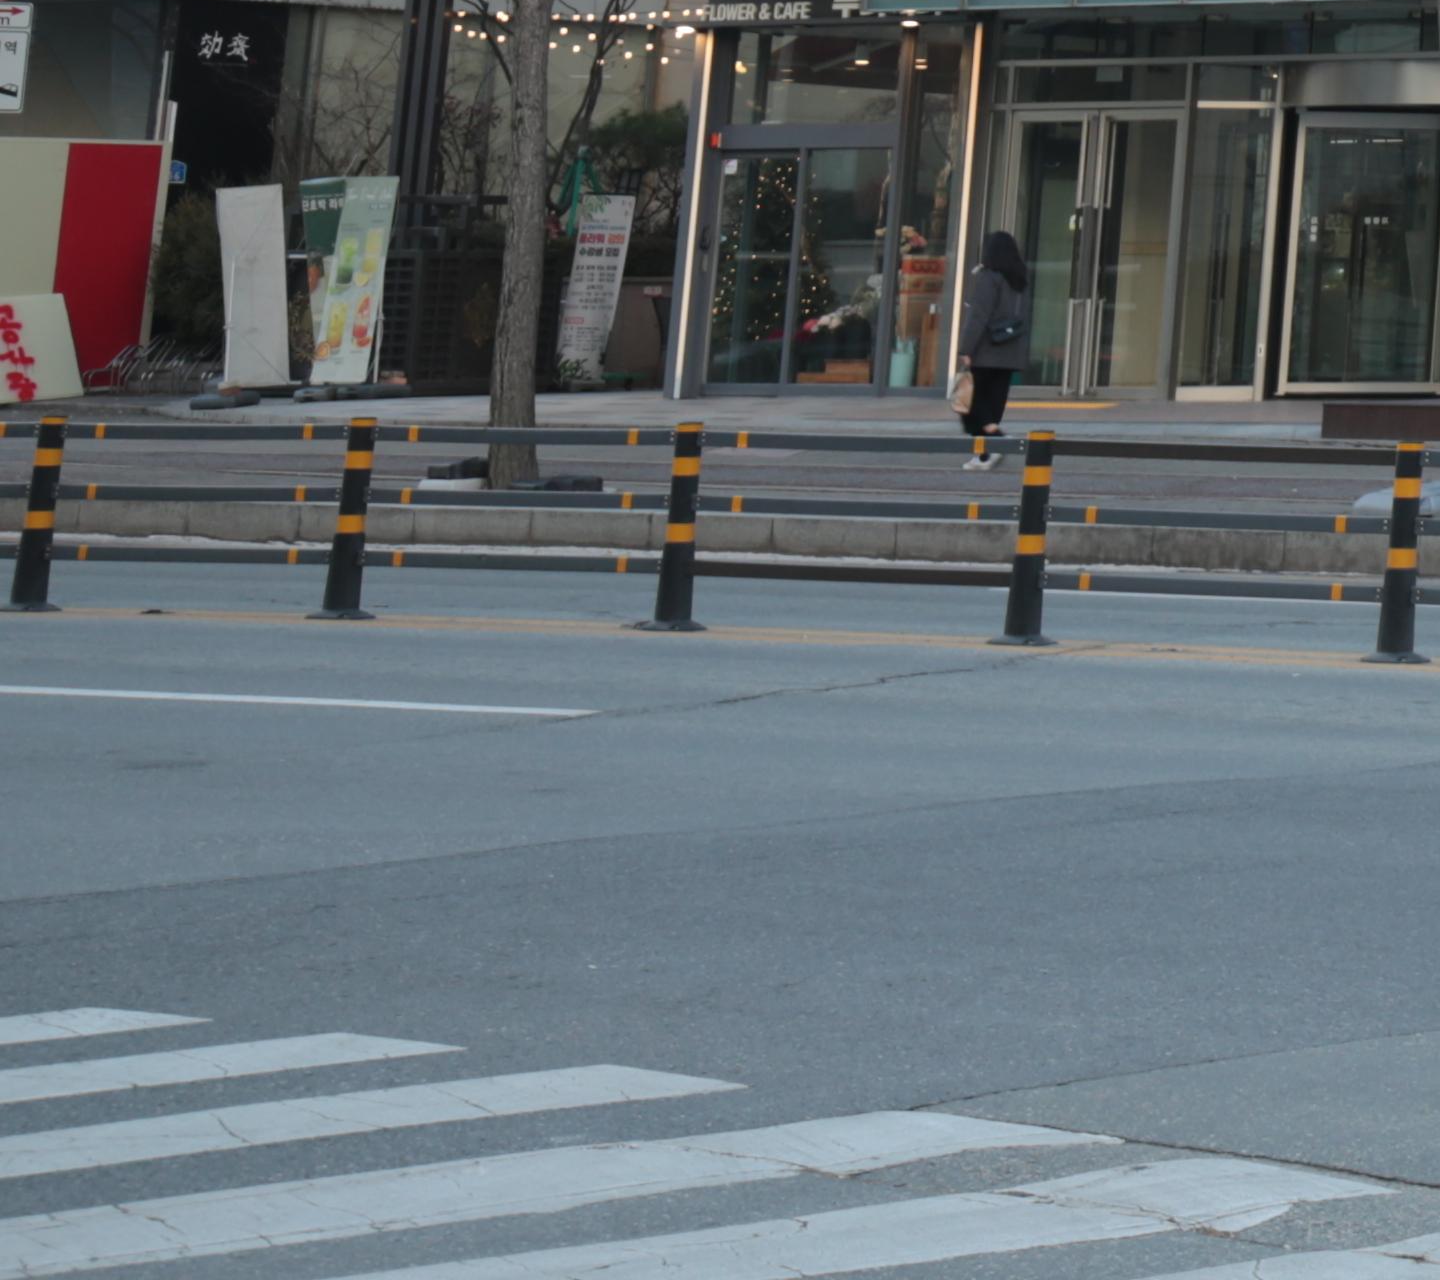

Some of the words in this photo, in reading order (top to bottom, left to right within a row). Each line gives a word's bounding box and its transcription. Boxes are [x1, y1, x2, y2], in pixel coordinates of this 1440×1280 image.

[704, 2, 756, 21] FLOWER
[759, 2, 770, 20] &
[774, 1, 812, 20] CAFE
